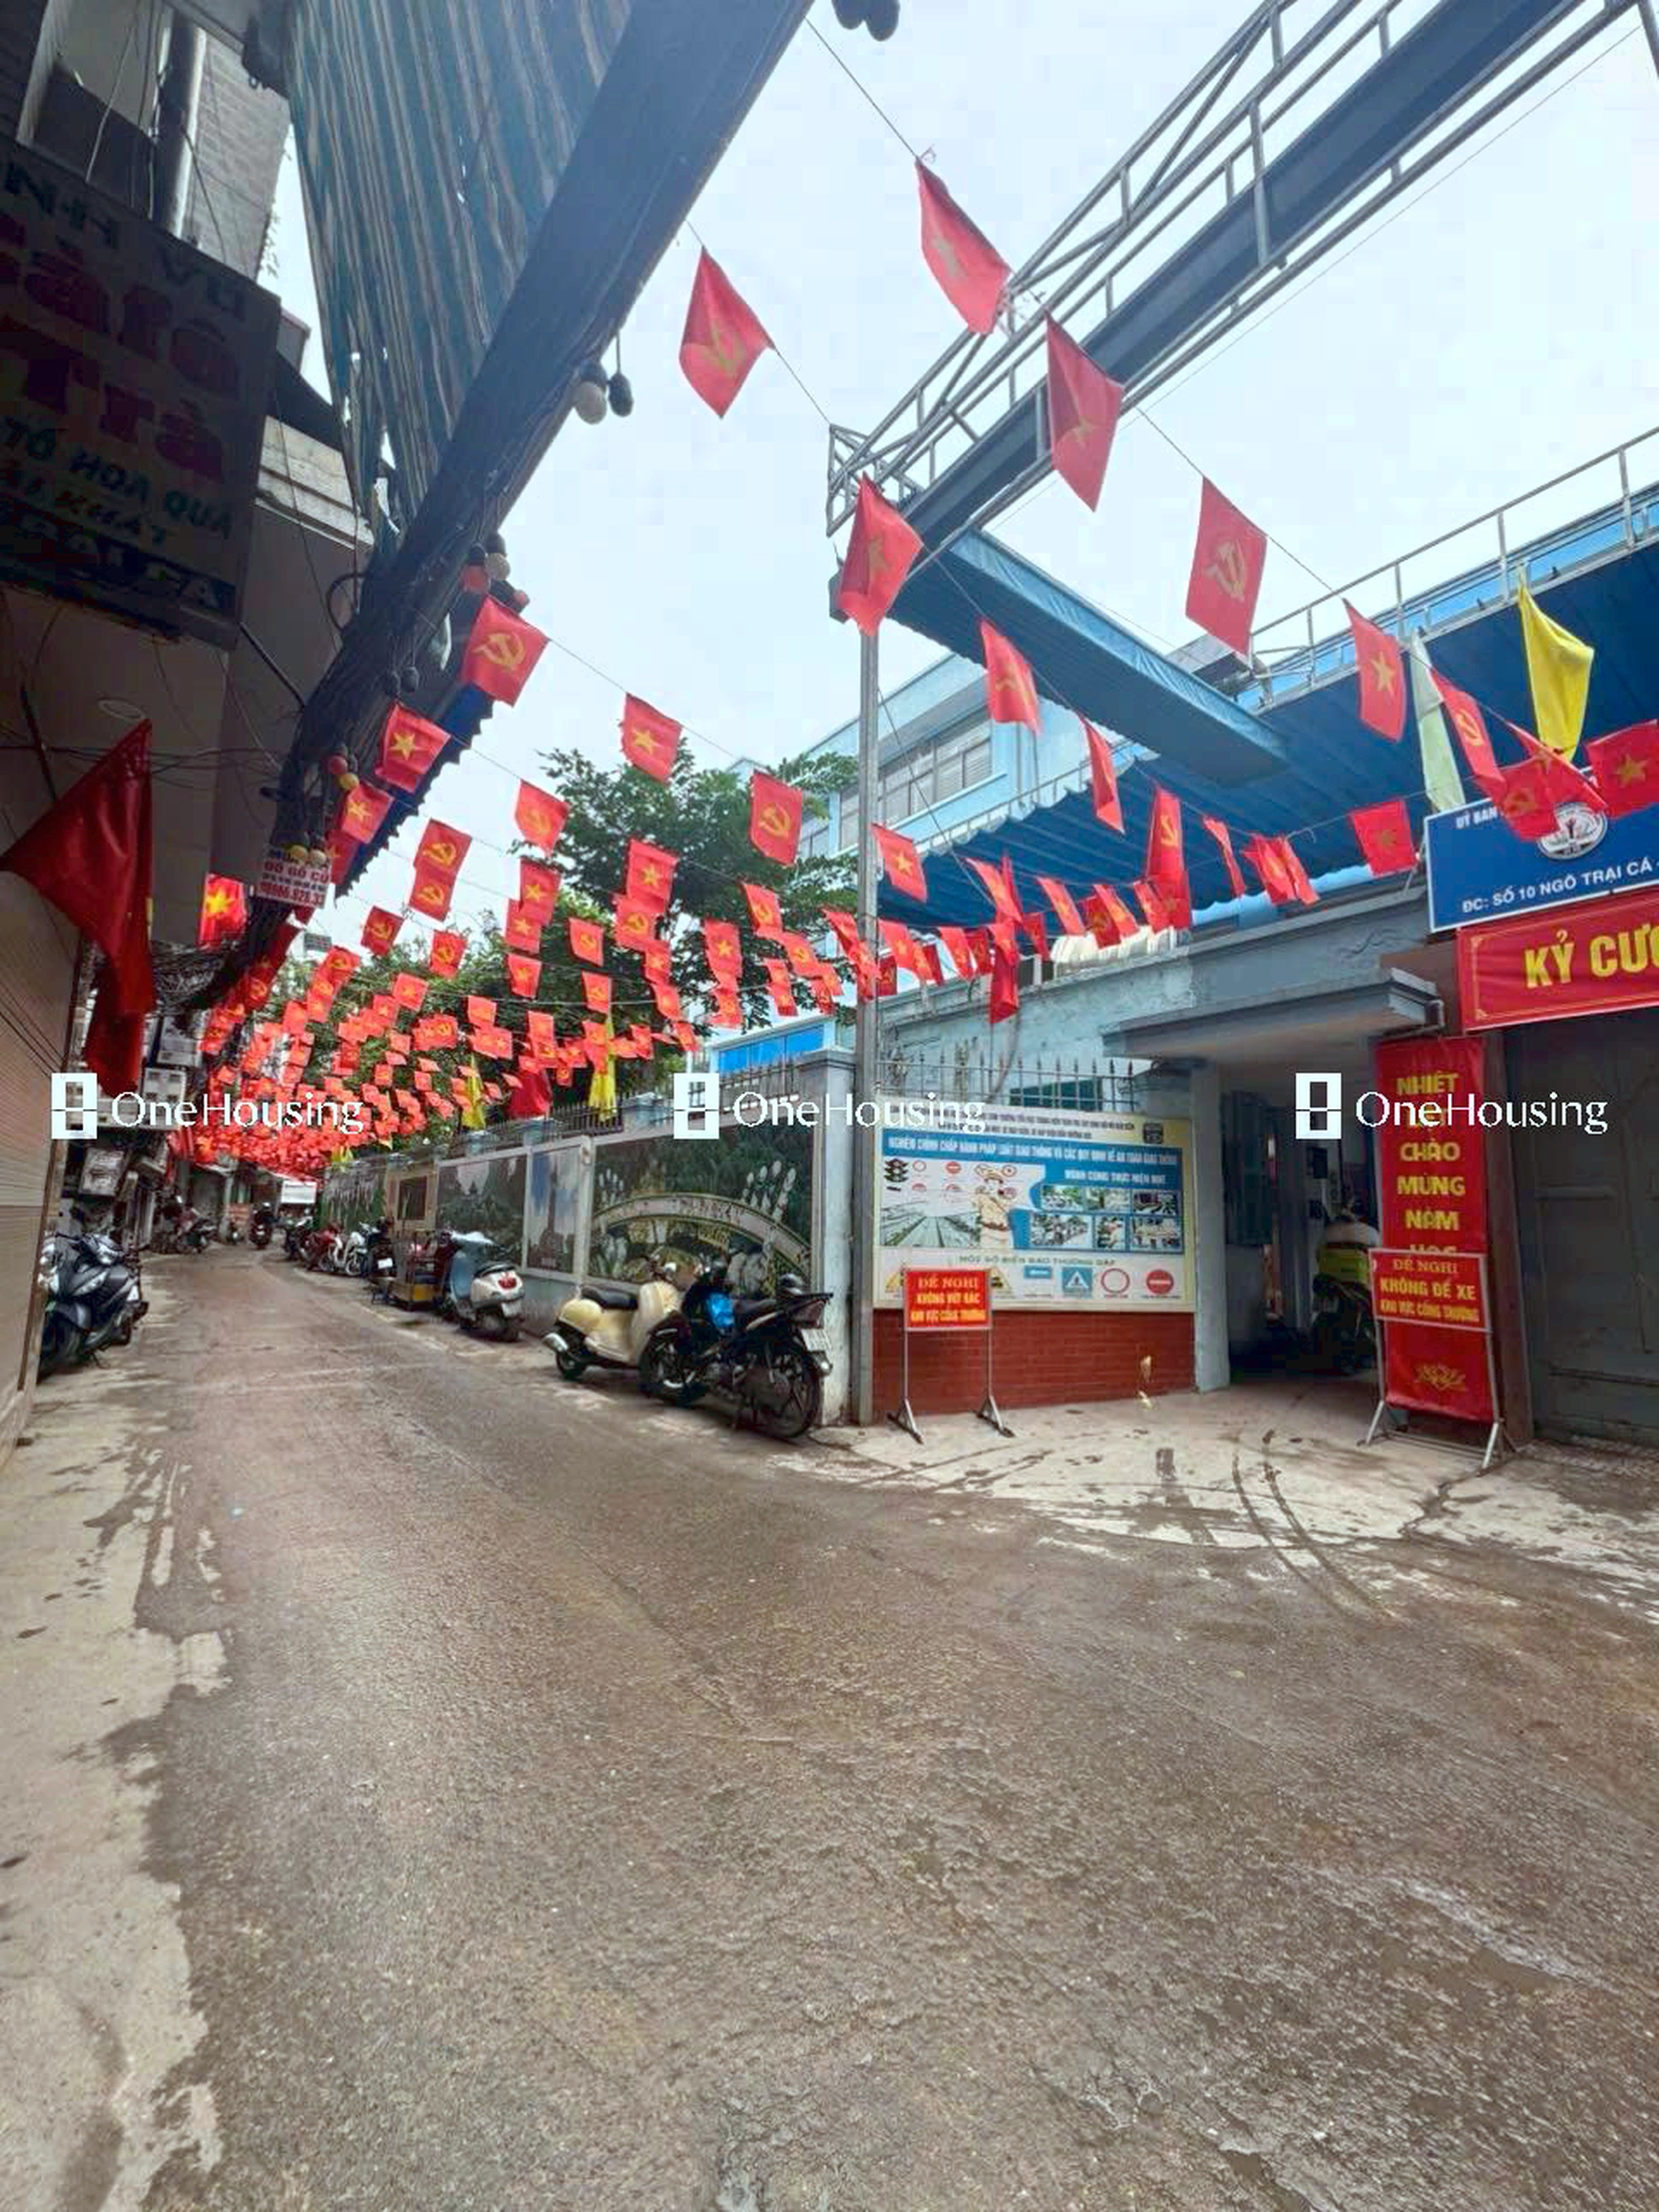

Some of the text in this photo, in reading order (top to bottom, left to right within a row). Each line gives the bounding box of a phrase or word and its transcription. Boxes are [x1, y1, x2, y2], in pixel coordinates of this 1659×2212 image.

[1461, 897, 1490, 914] ĐC:
[1492, 885, 1516, 906] SỐ
[1518, 885, 1536, 900] 10
[1580, 864, 1623, 885] TRẠI
[1524, 929, 1575, 989] KỶ
[1456, 1284, 1477, 1301] XE
